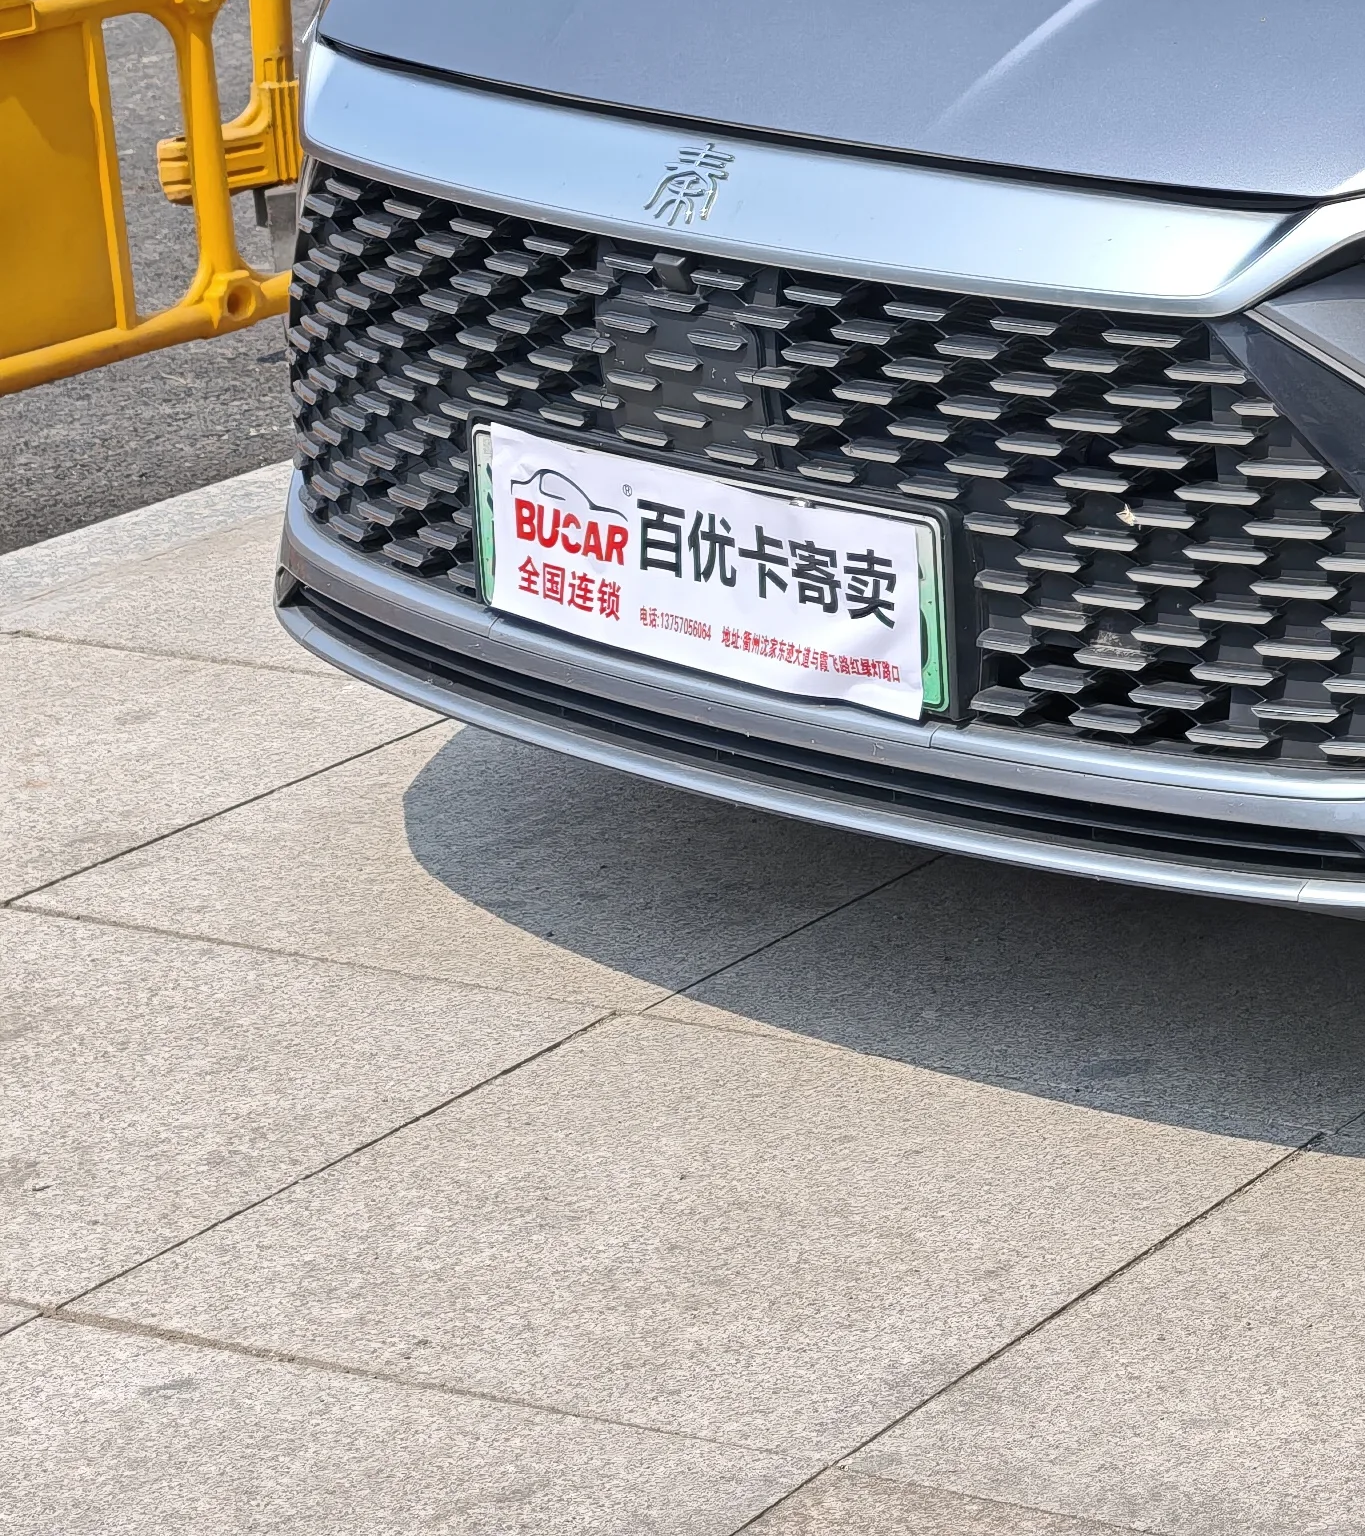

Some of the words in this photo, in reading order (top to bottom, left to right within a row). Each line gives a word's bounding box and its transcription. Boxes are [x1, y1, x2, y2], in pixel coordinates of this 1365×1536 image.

[514, 497, 629, 566] BUCAR
[636, 498, 897, 630] 百优卡寄卖
[518, 555, 622, 622] 全国连锁
